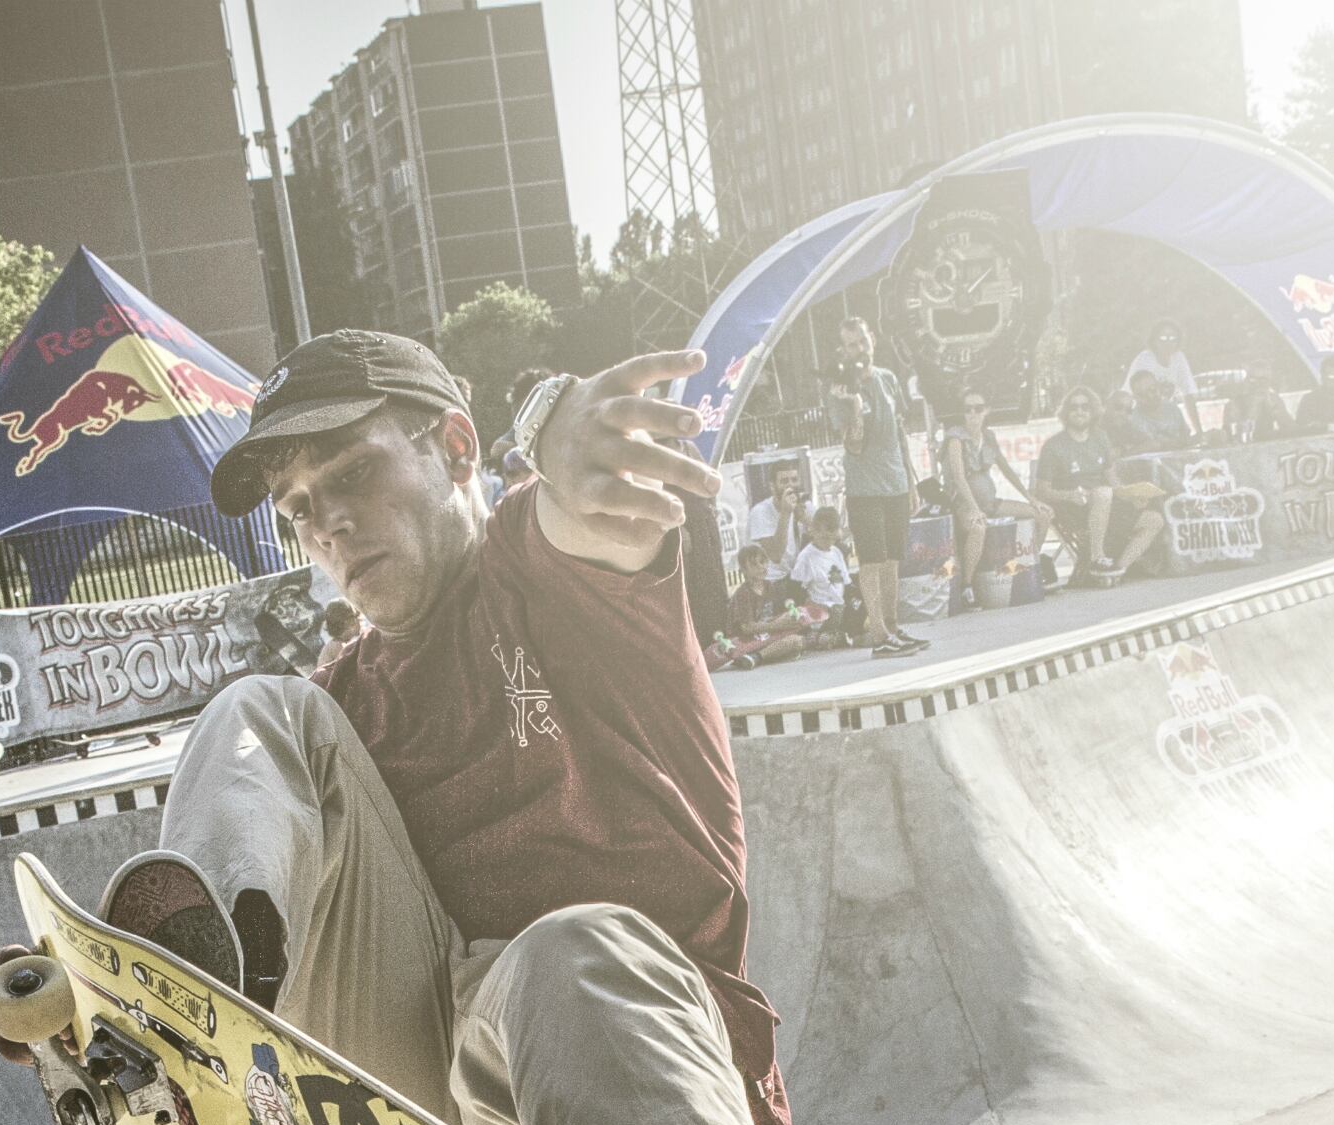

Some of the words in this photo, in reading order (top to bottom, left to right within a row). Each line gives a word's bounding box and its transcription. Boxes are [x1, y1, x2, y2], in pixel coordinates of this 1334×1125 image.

[36, 303, 124, 365] Red
[31, 591, 231, 654] TOUGHNESS
[40, 660, 89, 706] IN
[83, 625, 248, 709] BOWL
[1171, 686, 1209, 719] Red
[1203, 678, 1239, 711] Bull
